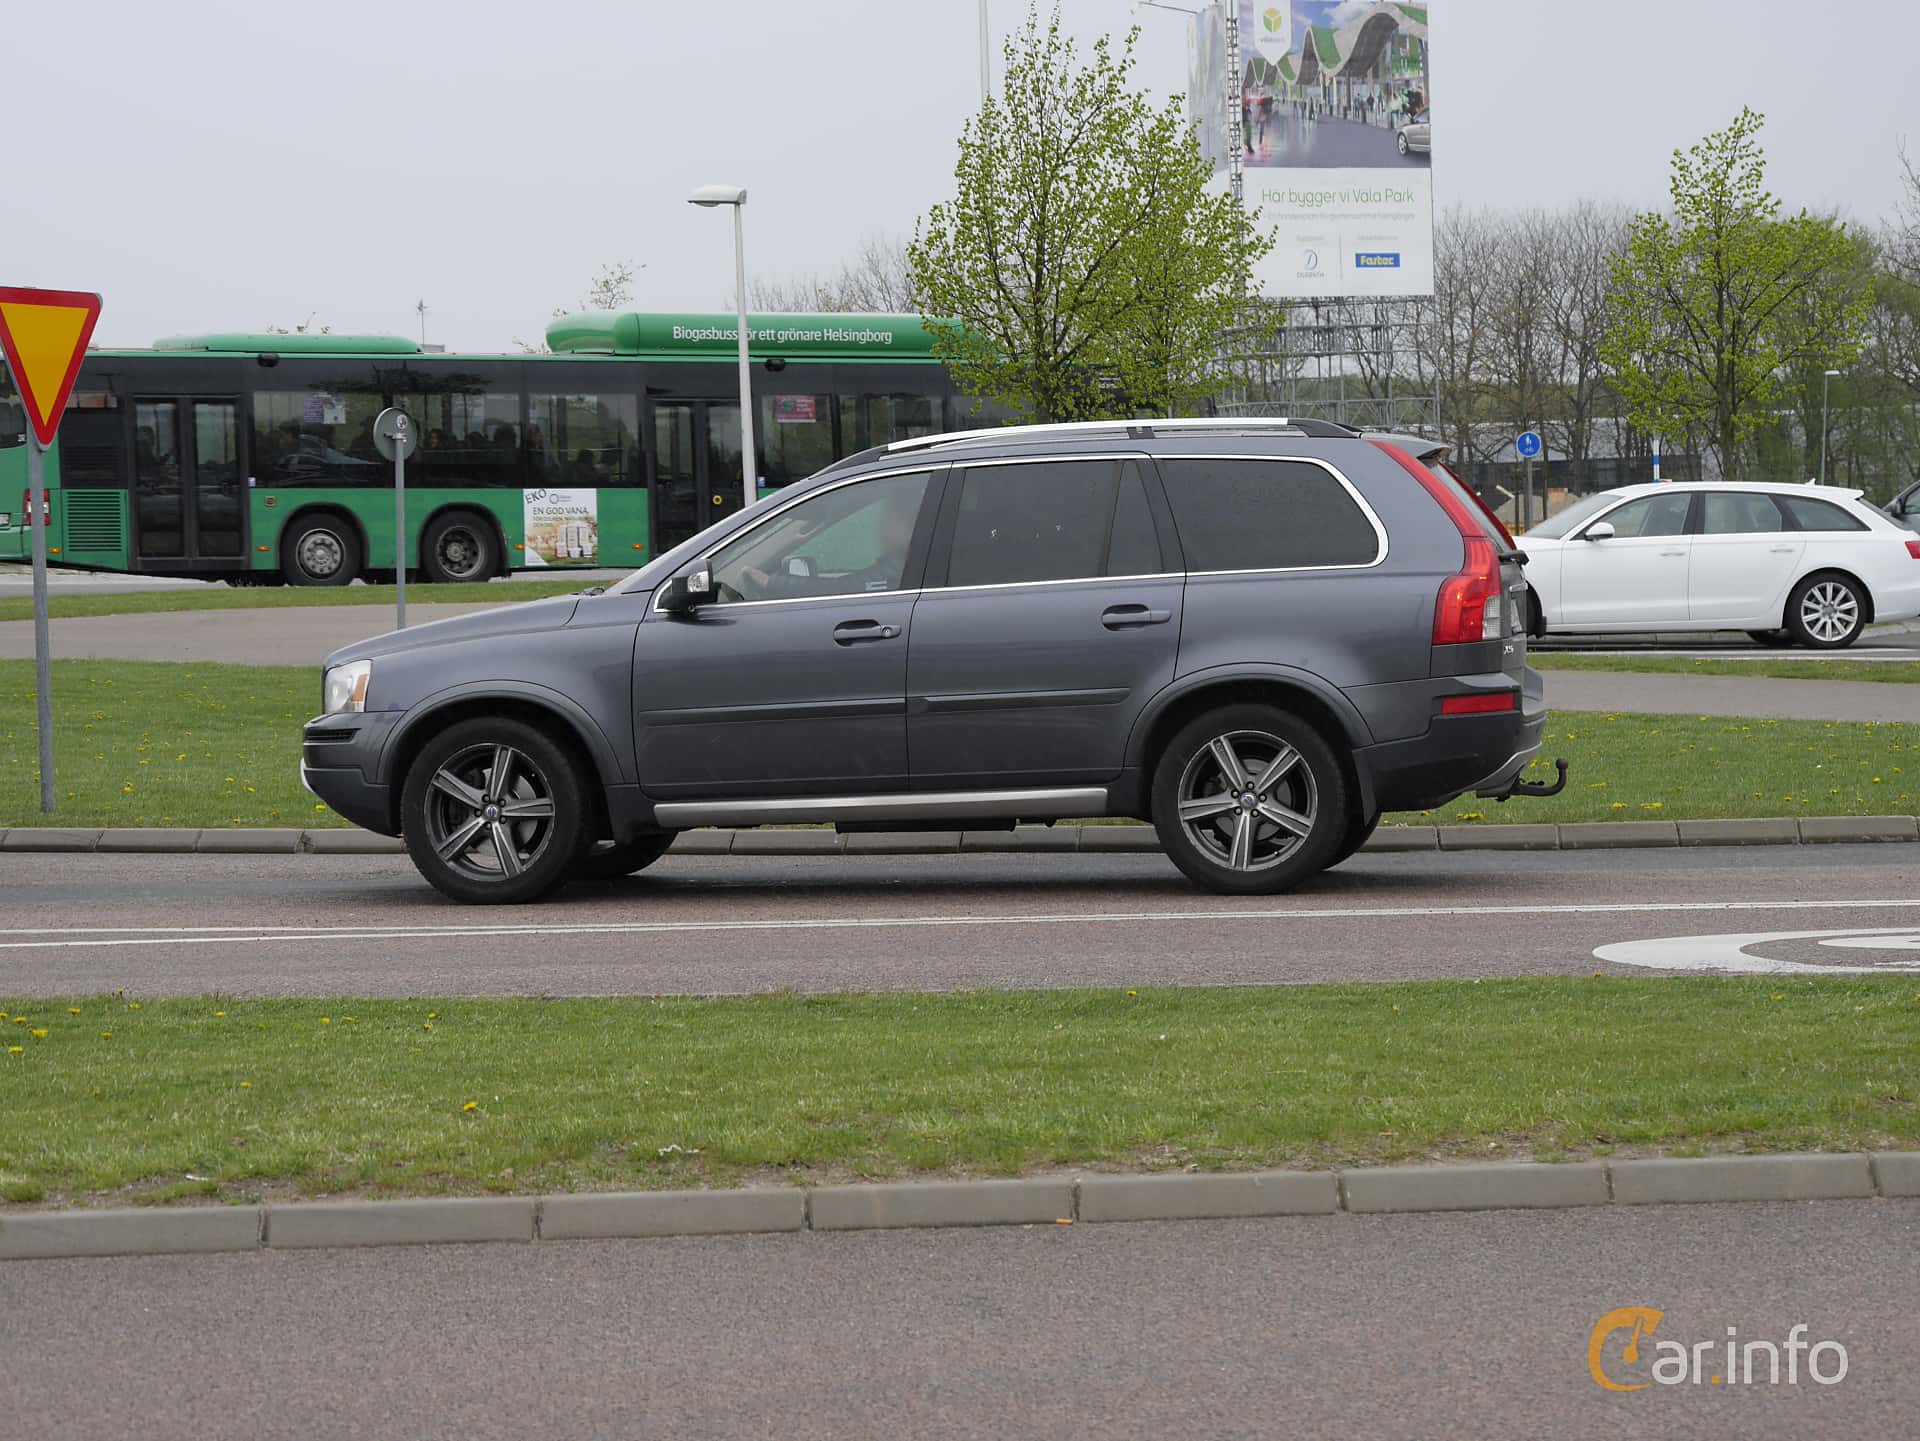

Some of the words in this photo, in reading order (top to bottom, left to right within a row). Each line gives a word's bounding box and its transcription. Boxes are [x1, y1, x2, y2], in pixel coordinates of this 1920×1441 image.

[1289, 187, 1336, 207] bygger
[1340, 191, 1349, 202] vi
[1385, 188, 1415, 203] Park
[673, 326, 738, 342] Biogasbuss
[759, 329, 776, 340] ett
[777, 328, 822, 343] grönare
[823, 328, 892, 344] Helsingborg
[525, 488, 546, 504] EKO
